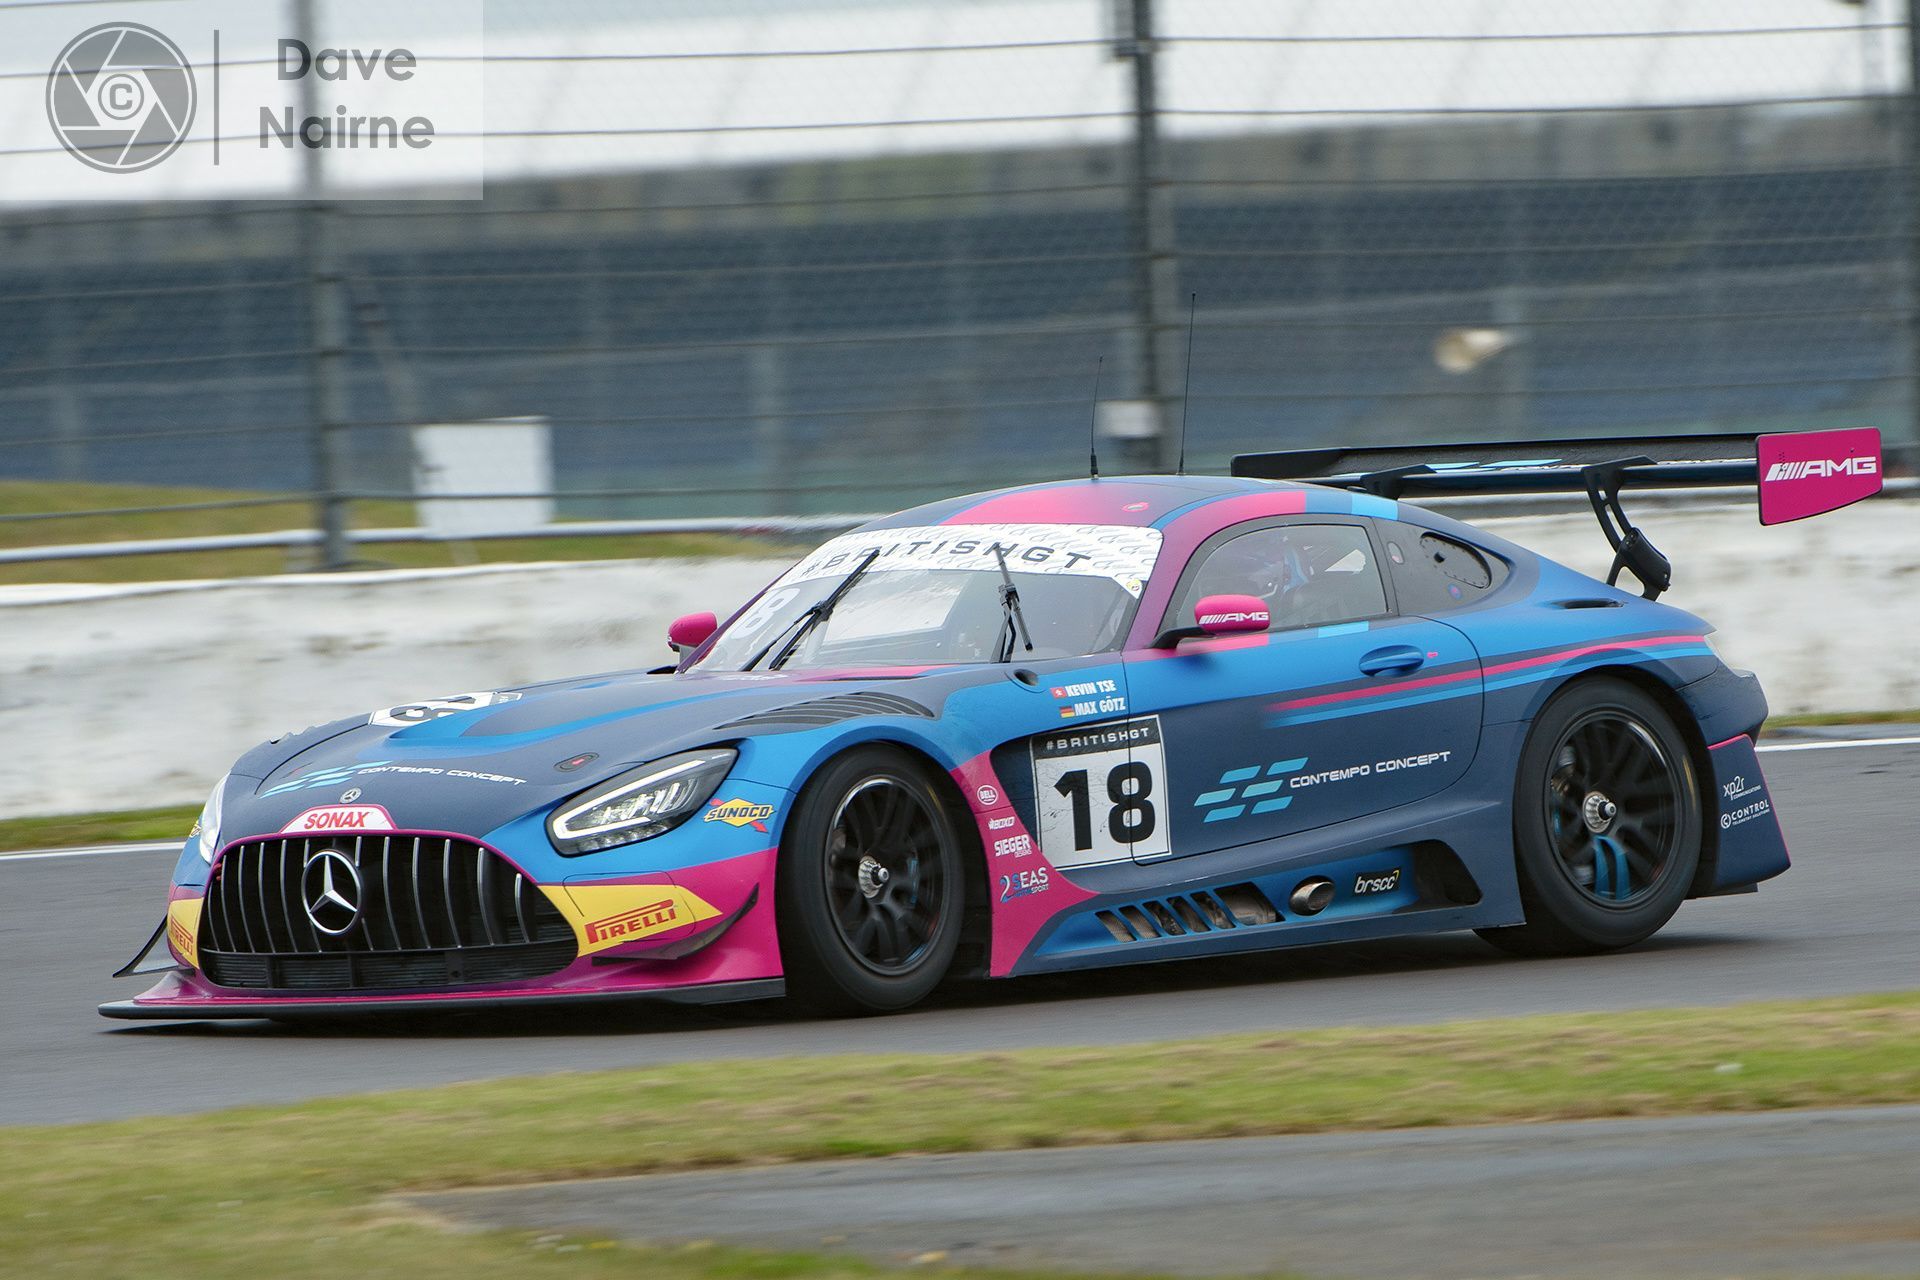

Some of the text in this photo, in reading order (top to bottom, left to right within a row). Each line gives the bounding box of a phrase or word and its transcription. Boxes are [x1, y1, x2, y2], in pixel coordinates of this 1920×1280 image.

[1801, 456, 1877, 479] AMG
[1222, 611, 1269, 623] AMG
[1065, 680, 1117, 697] KEVIN TSE
[1074, 699, 1098, 716] MAX
[1046, 727, 1150, 750] #BRITISHGT
[357, 766, 527, 786] CONTEMPO CONCEPT
[1290, 751, 1451, 788] CONTEMPO CONCEPT
[979, 789, 996, 800] BELL
[704, 806, 770, 819] SUNOCO
[1054, 761, 1156, 851] 18
[1731, 799, 1769, 820] CONTROL
[303, 811, 371, 830] SONAX
[994, 834, 1031, 857] SIEGER
[1012, 867, 1048, 890] SEAS
[1354, 875, 1396, 894] brscc
[584, 899, 677, 944] PIRELLI
